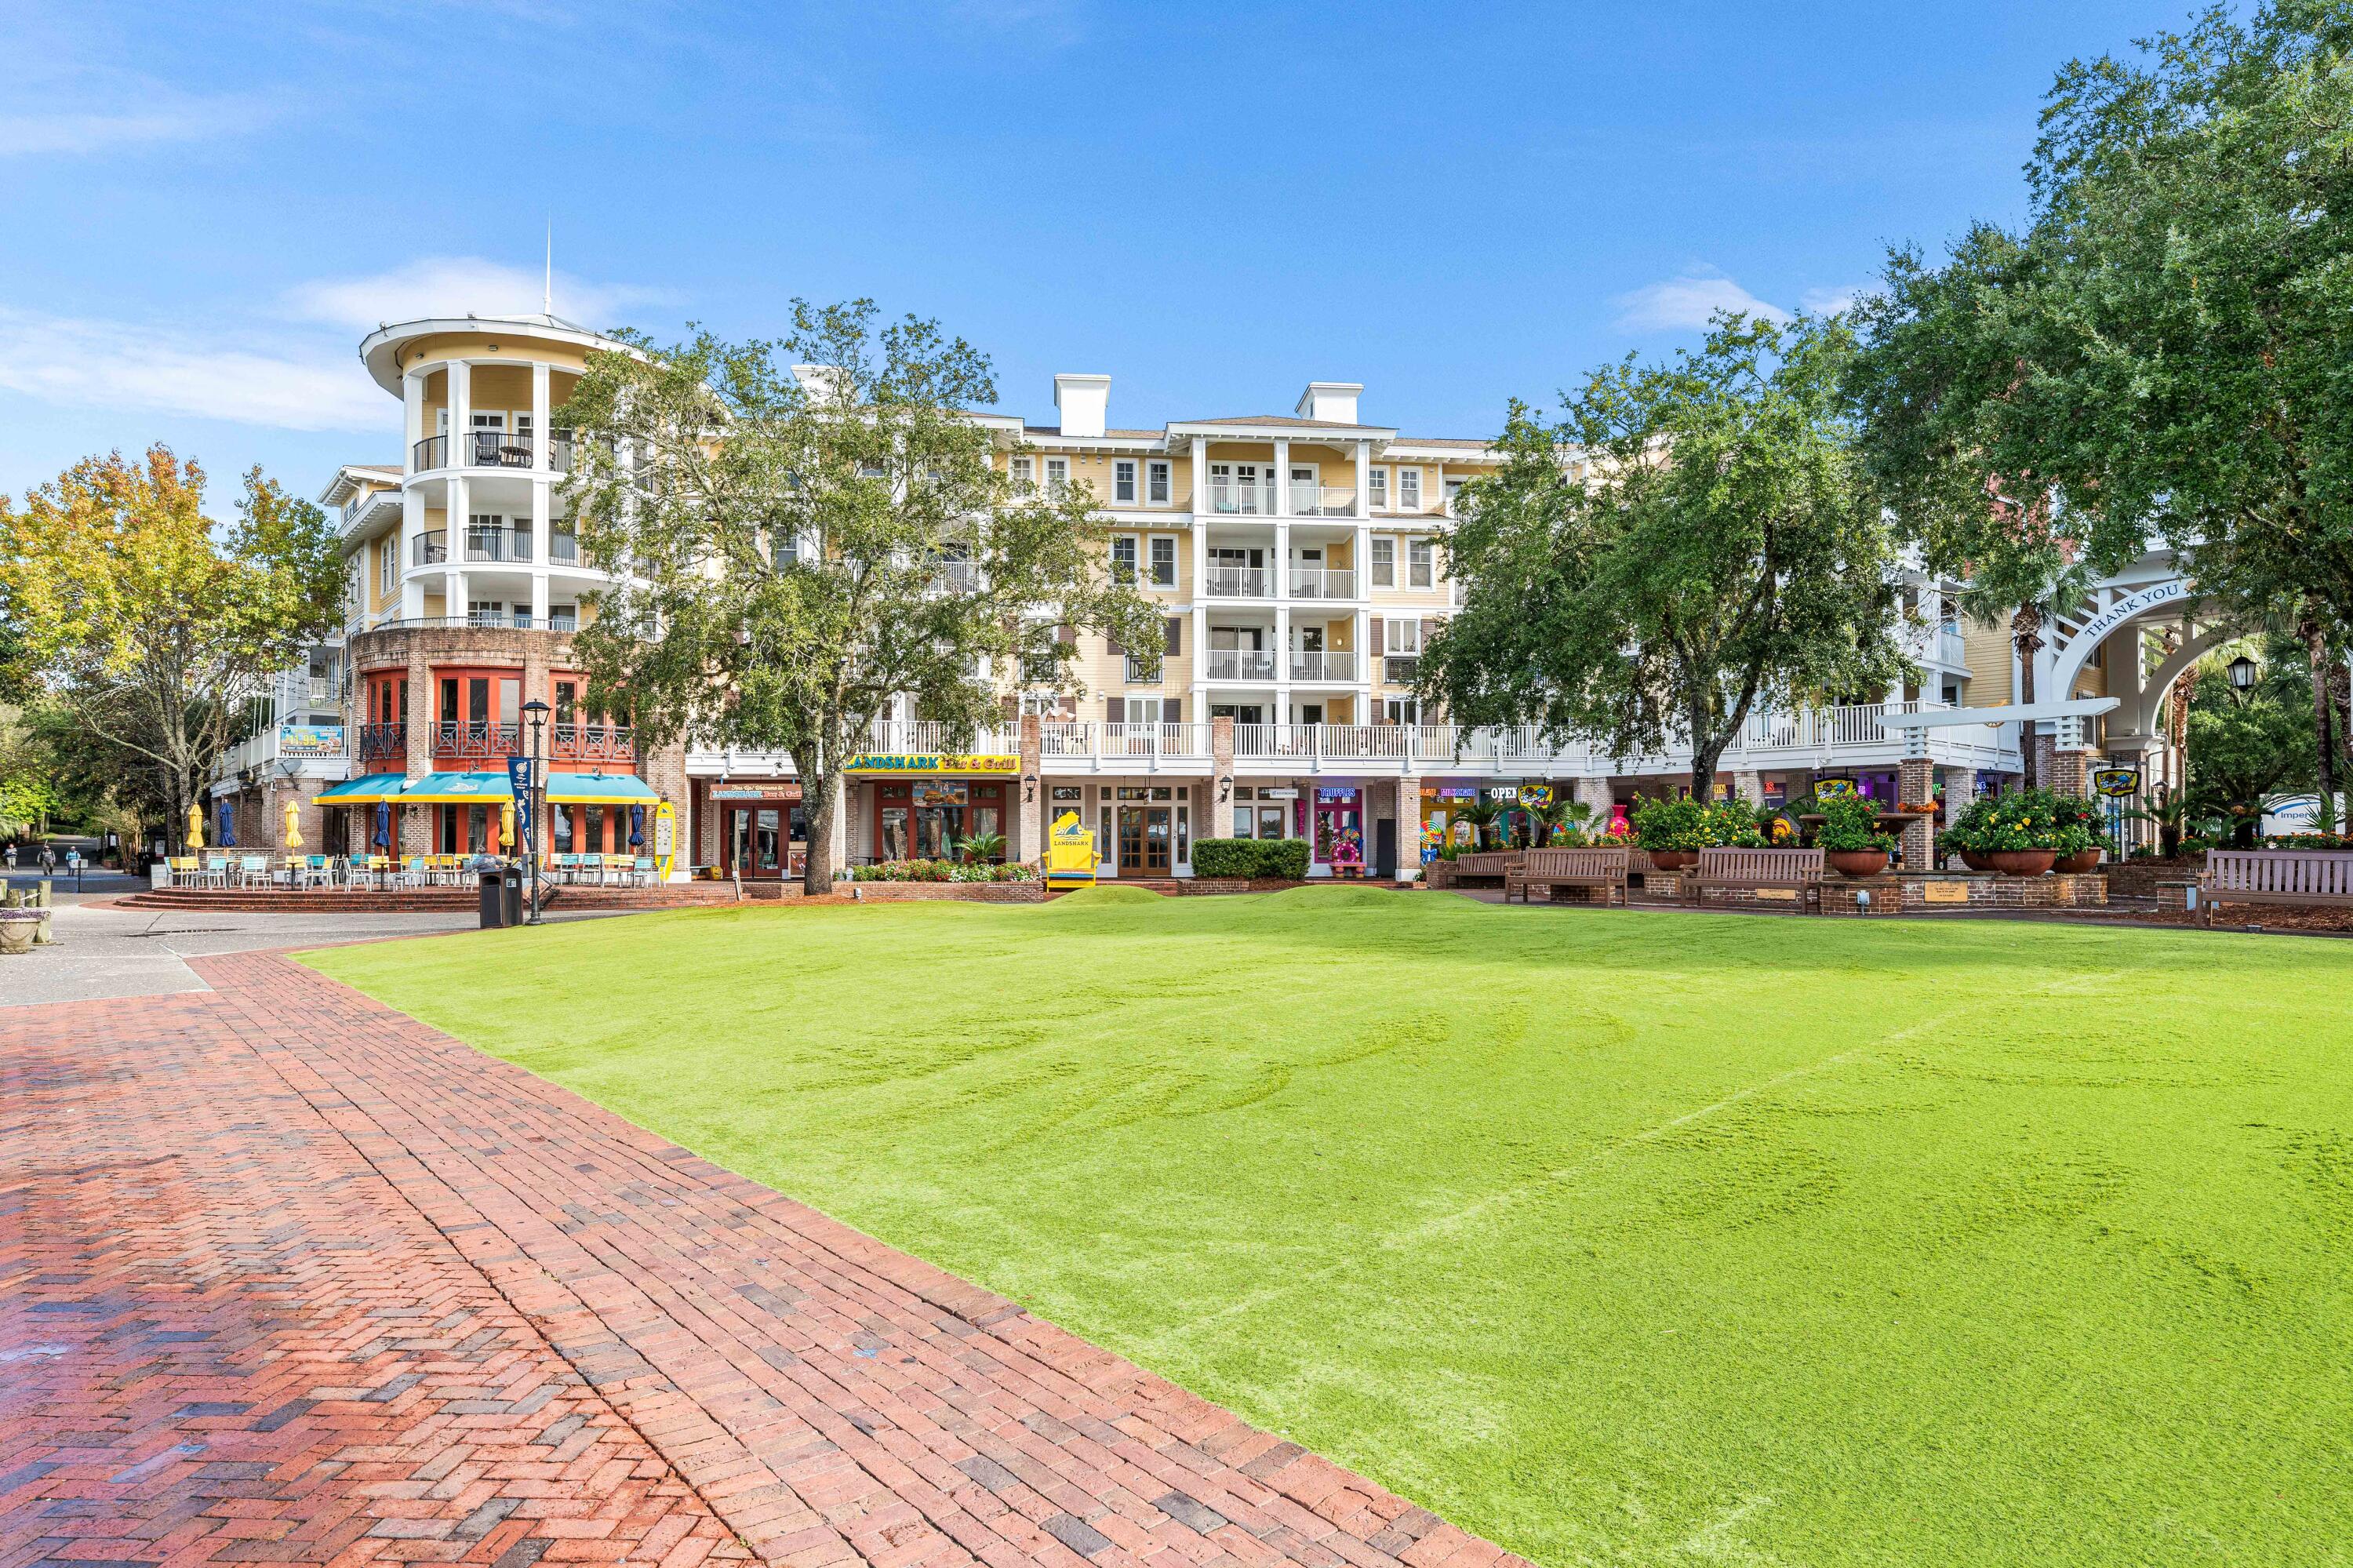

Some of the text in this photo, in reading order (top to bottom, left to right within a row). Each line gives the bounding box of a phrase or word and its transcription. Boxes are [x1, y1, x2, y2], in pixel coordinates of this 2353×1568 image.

[2085, 584, 2178, 637] THANK YOU
[969, 759, 980, 769] &
[984, 758, 1017, 769] Grill
[2100, 780, 2123, 789] Sugar
[1320, 788, 1355, 798] TRUFFLES
[1440, 788, 1475, 797] MILKSHAKE
[1520, 795, 1541, 804] Sugar
